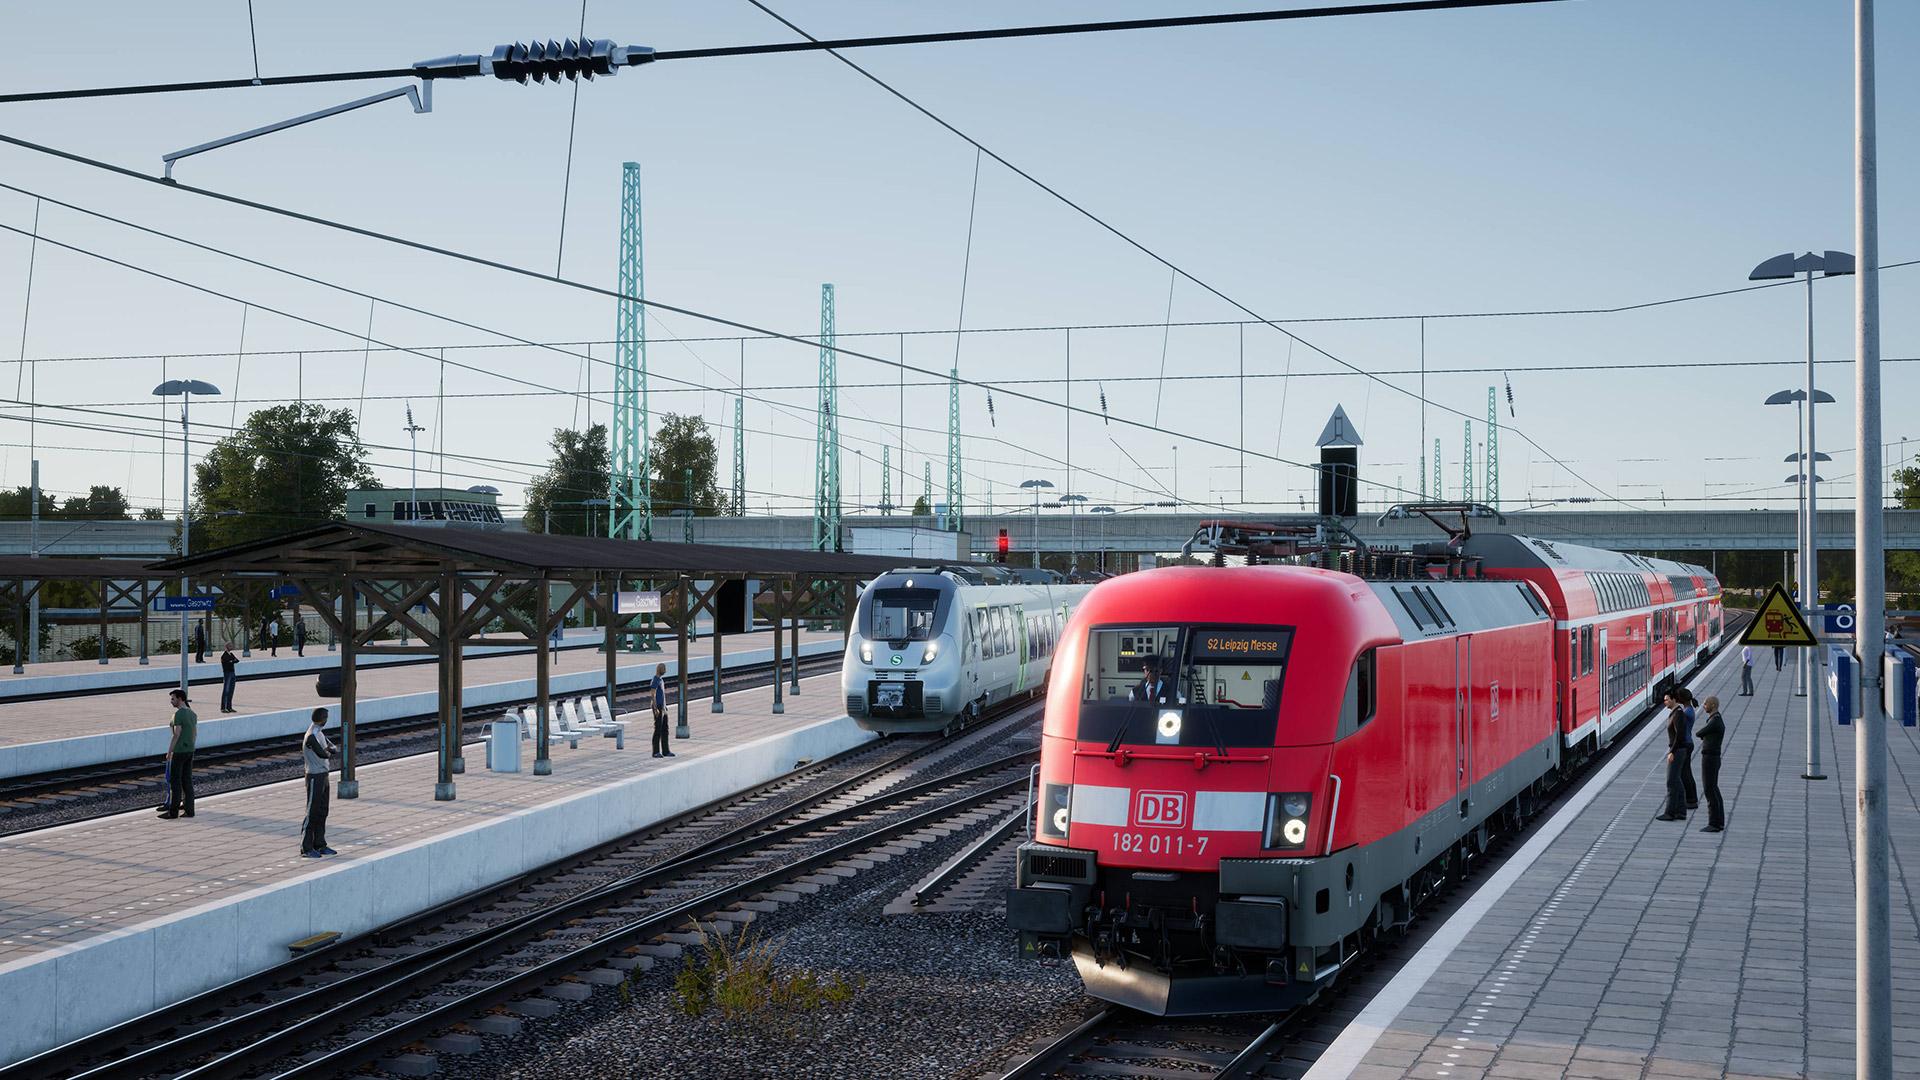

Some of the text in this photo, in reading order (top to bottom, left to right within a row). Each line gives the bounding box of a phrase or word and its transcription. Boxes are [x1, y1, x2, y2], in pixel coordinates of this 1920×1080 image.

[1207, 638, 1278, 653] S2 Leipzig Messe
[892, 655, 902, 666] S
[1140, 796, 1181, 822] DB
[1113, 832, 1209, 856] 182 011-7
